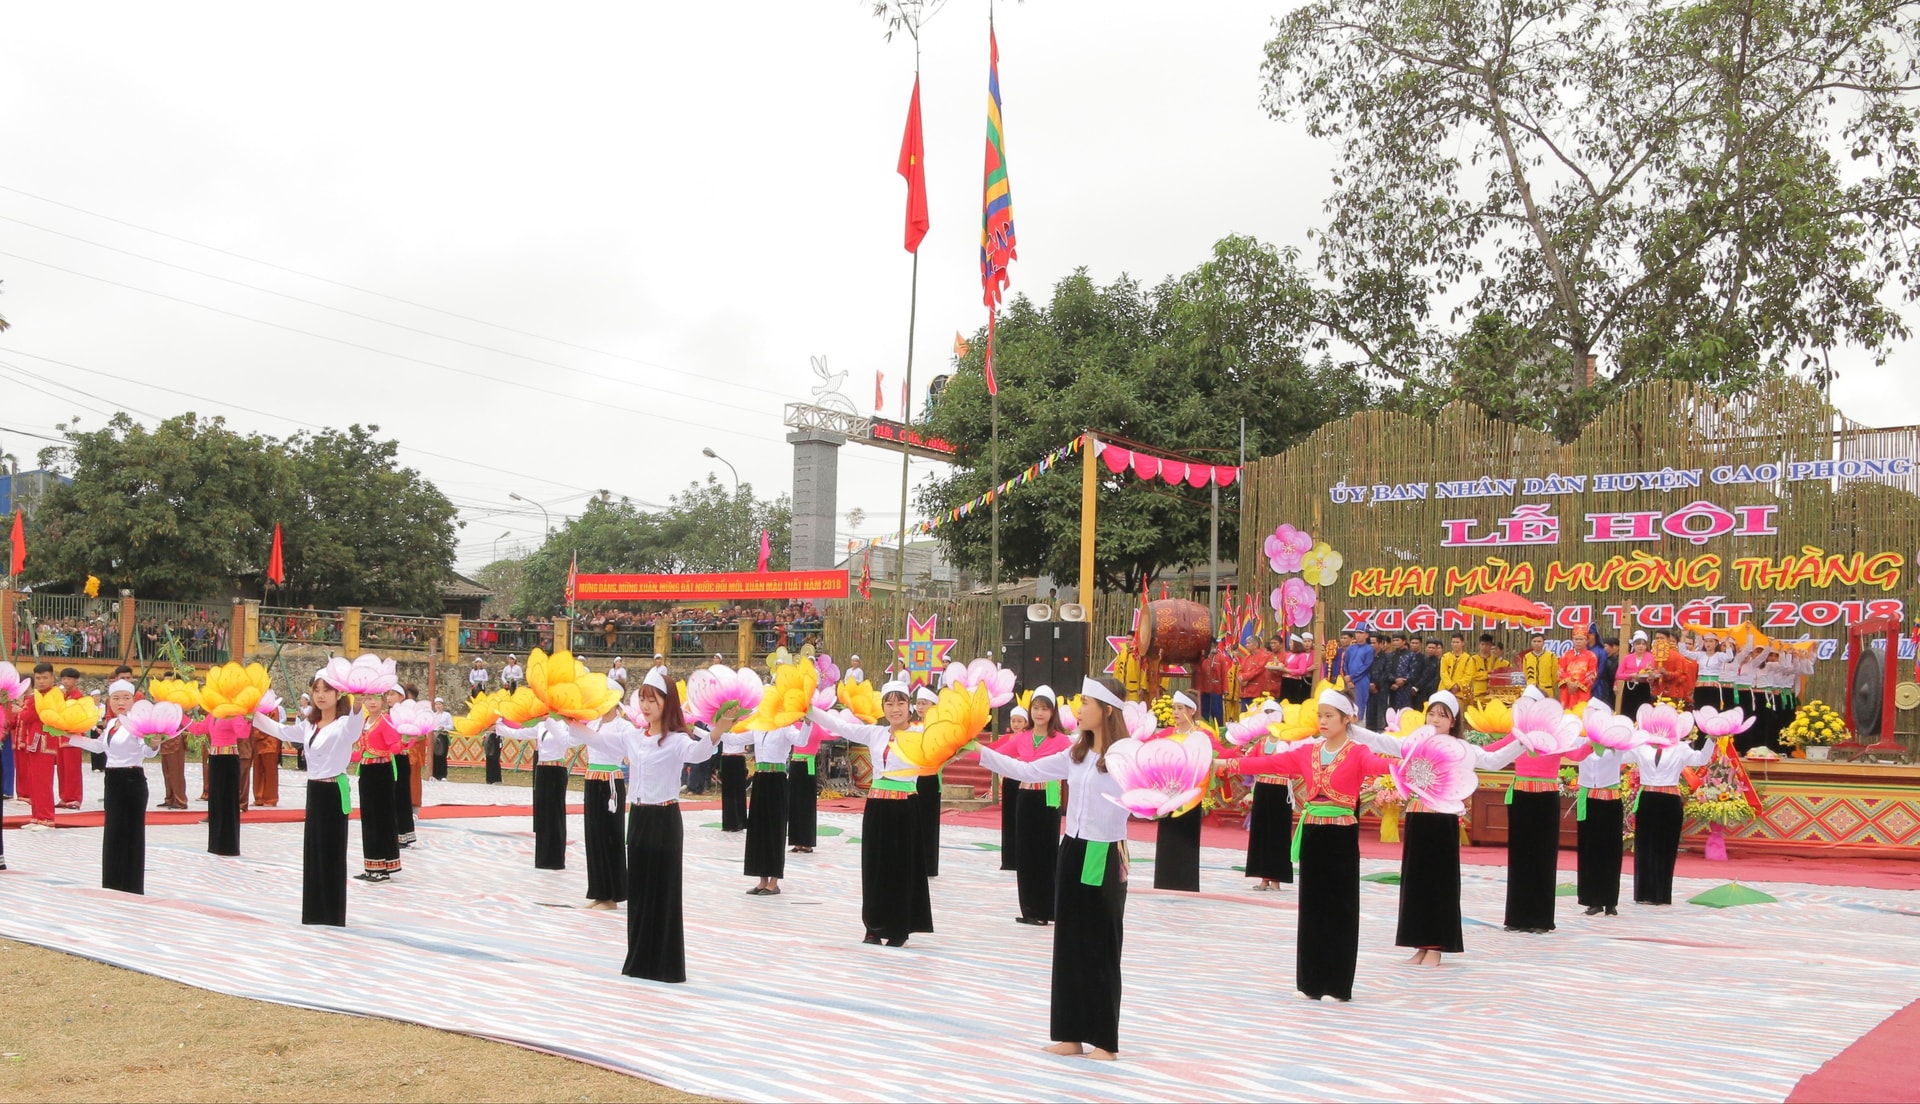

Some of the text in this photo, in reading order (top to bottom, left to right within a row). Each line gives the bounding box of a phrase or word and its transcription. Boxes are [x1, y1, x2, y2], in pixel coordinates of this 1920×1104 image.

[1330, 457, 1914, 503] ỦY BAN NHÂN DÂN HUYỆN CAO PHONG
[1440, 501, 1778, 547] LỄ HỘI
[822, 579, 842, 590] 2018
[1349, 545, 1904, 597] KHAI MÙA MƯỜNG THÀNG
[1602, 596, 1752, 630] TUẤT
[1763, 599, 1904, 627] 2018
